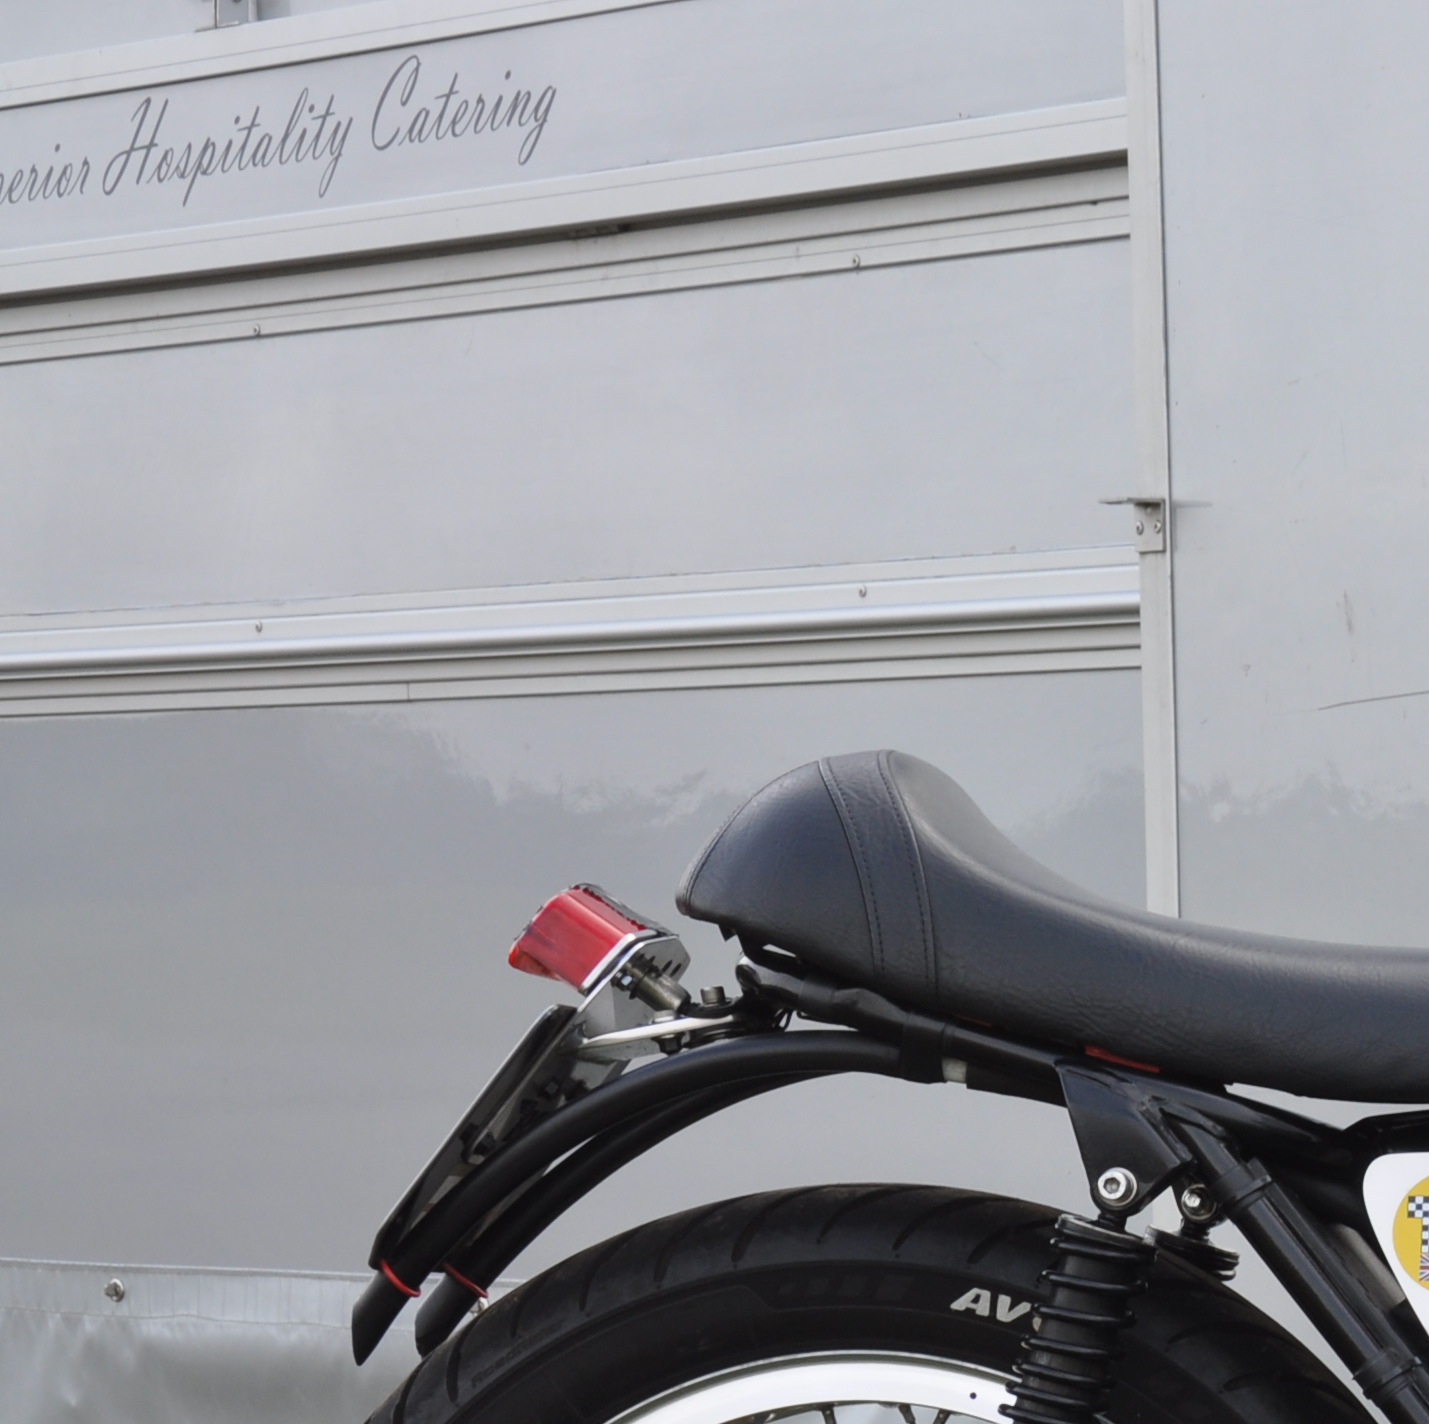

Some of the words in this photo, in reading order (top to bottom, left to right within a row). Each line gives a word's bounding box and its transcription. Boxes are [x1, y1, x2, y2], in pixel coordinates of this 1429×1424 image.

[102, 87, 353, 207] Hospitality
[371, 55, 557, 166] Catering
[949, 1286, 1043, 1332] AV
